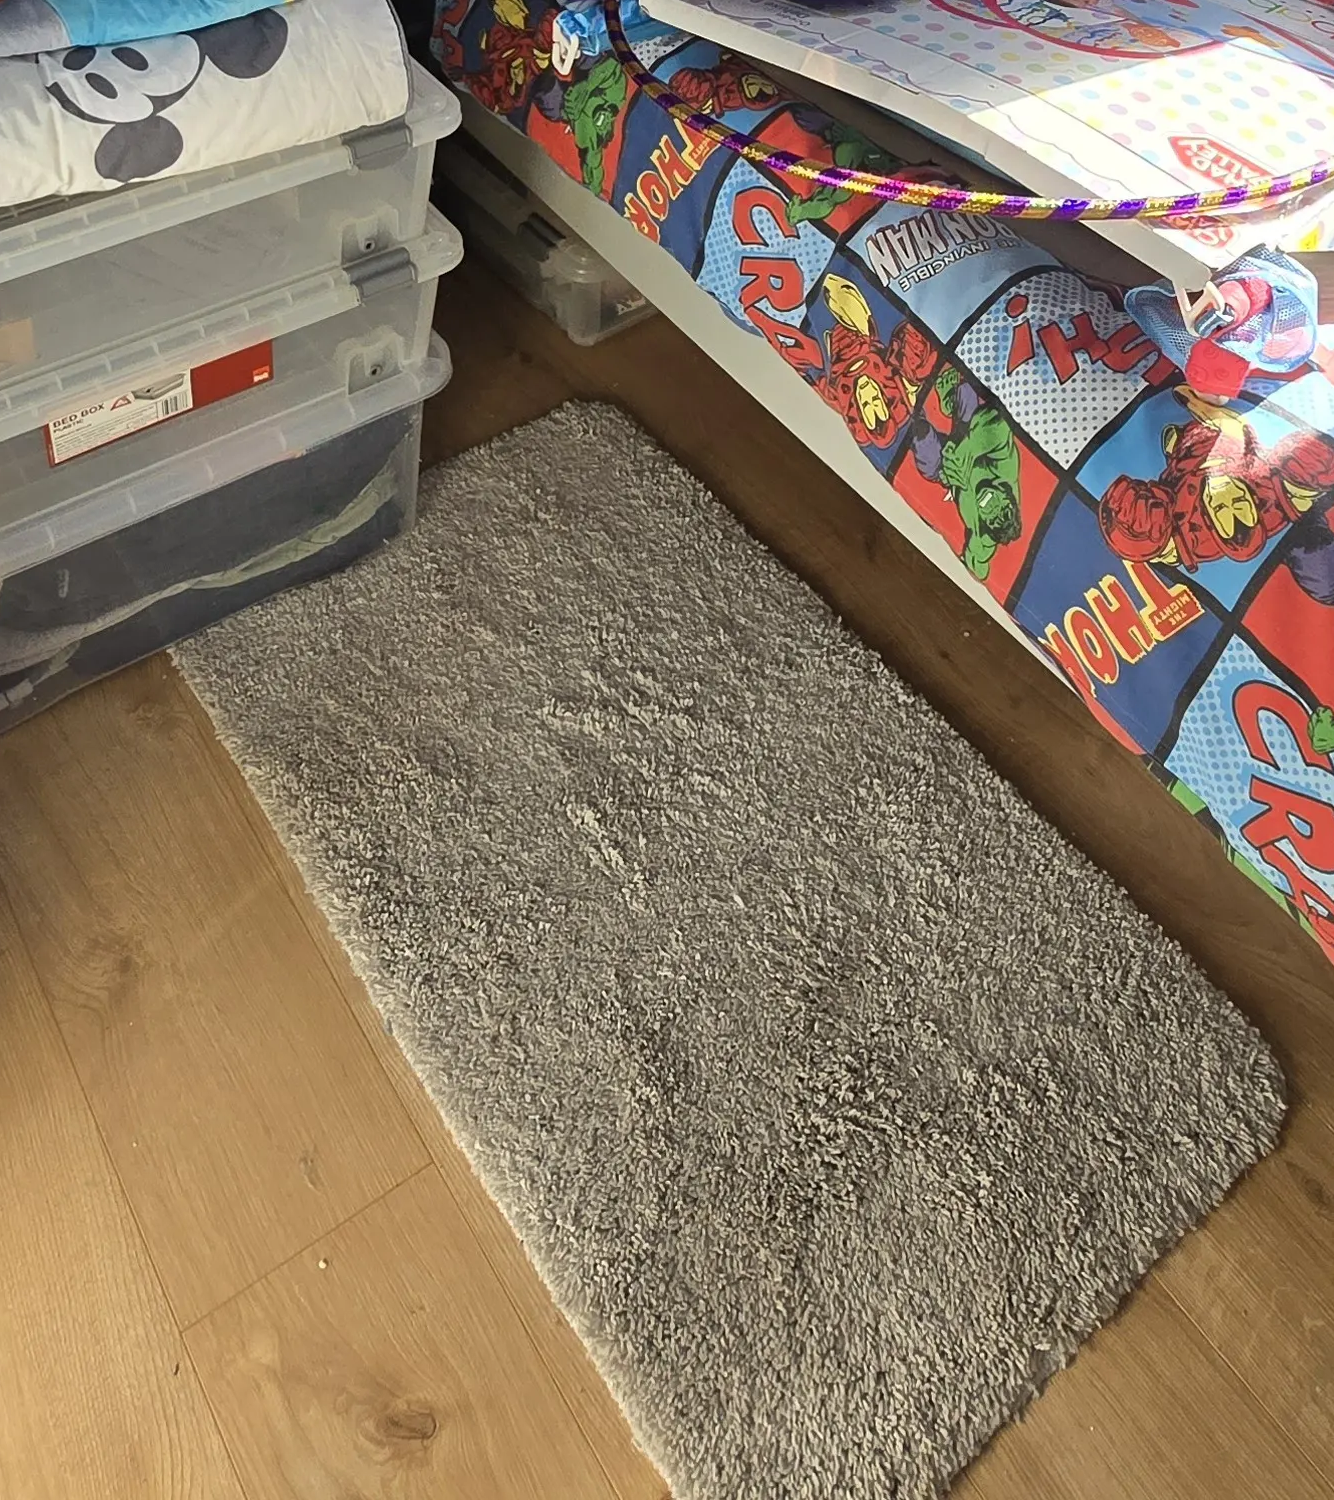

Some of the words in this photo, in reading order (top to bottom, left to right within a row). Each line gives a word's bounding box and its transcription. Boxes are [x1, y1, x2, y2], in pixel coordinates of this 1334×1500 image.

[864, 209, 948, 288] MAN
[898, 240, 990, 293] INVINCIBLE
[52, 413, 78, 429] BED
[80, 403, 106, 420] BOX
[1153, 592, 1191, 626] MIGHTY
[1168, 610, 1187, 626] THE
